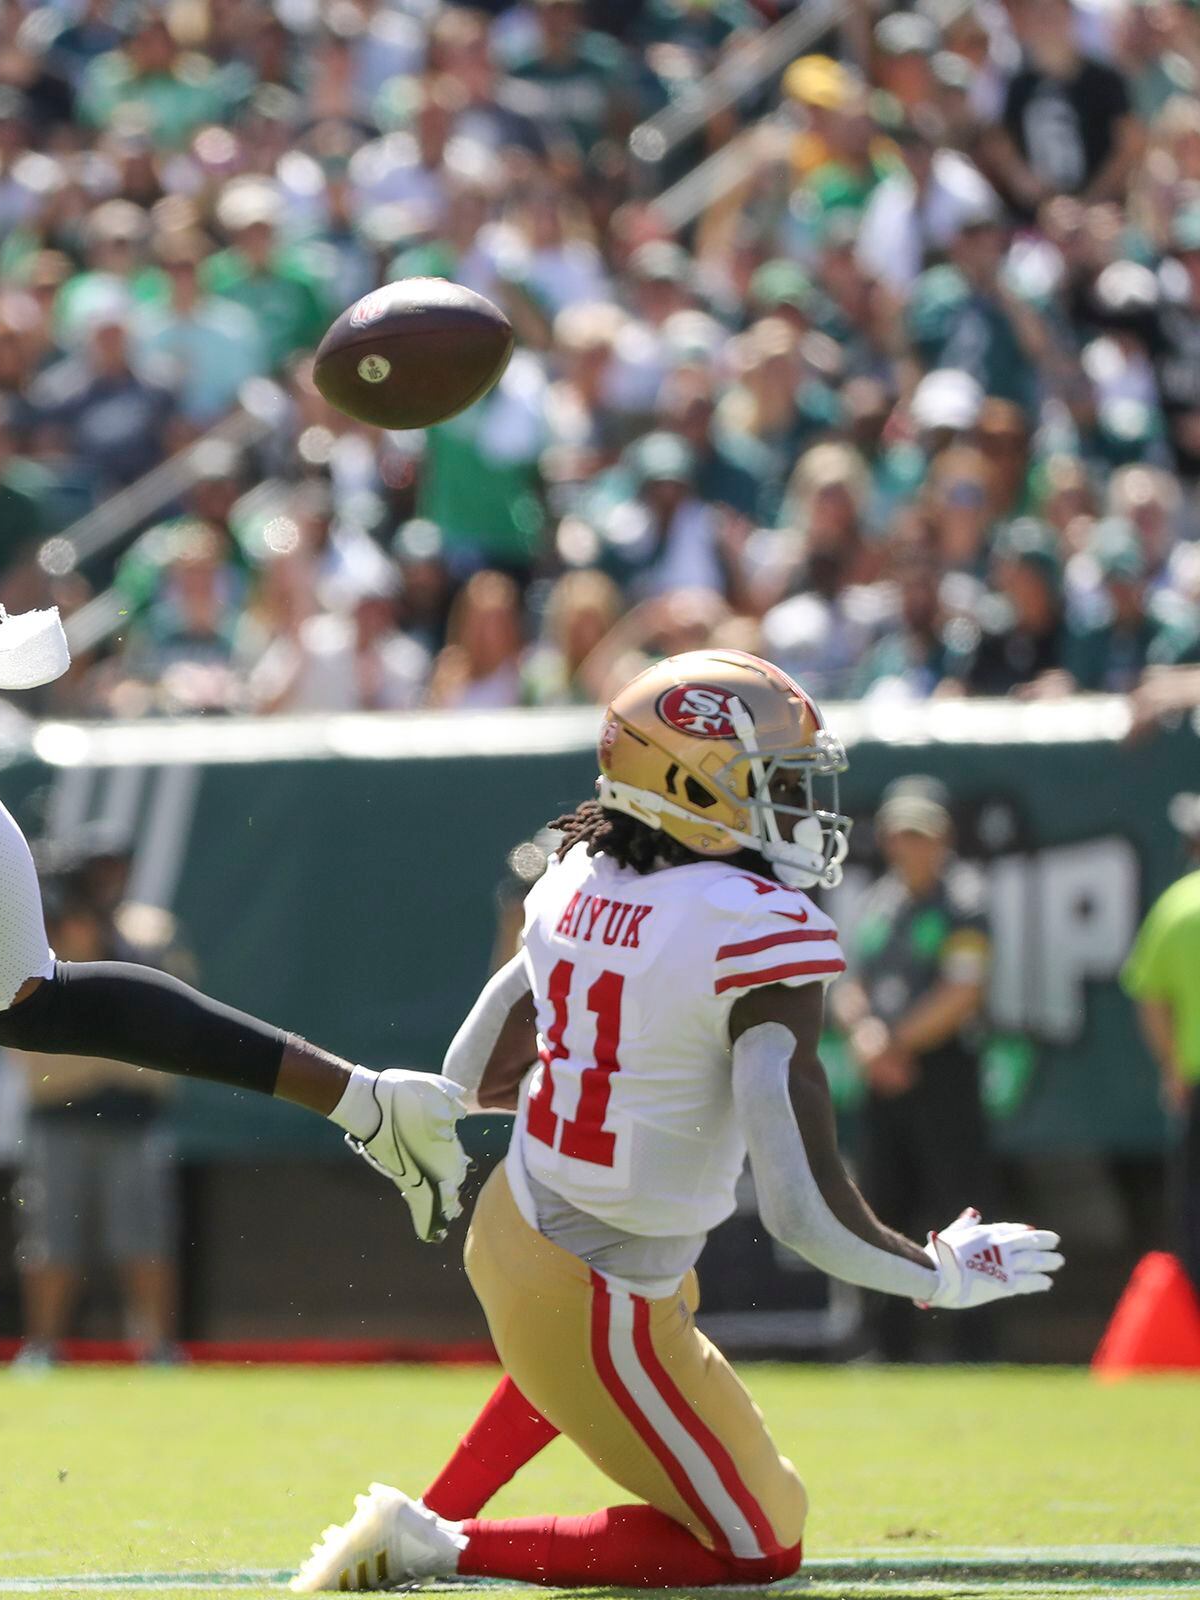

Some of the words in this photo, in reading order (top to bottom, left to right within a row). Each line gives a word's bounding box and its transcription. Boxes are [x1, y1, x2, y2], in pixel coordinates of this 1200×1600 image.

[556, 889, 653, 948] AIYUK
[527, 959, 625, 1168] 11
[966, 1258, 1008, 1282] adidas
